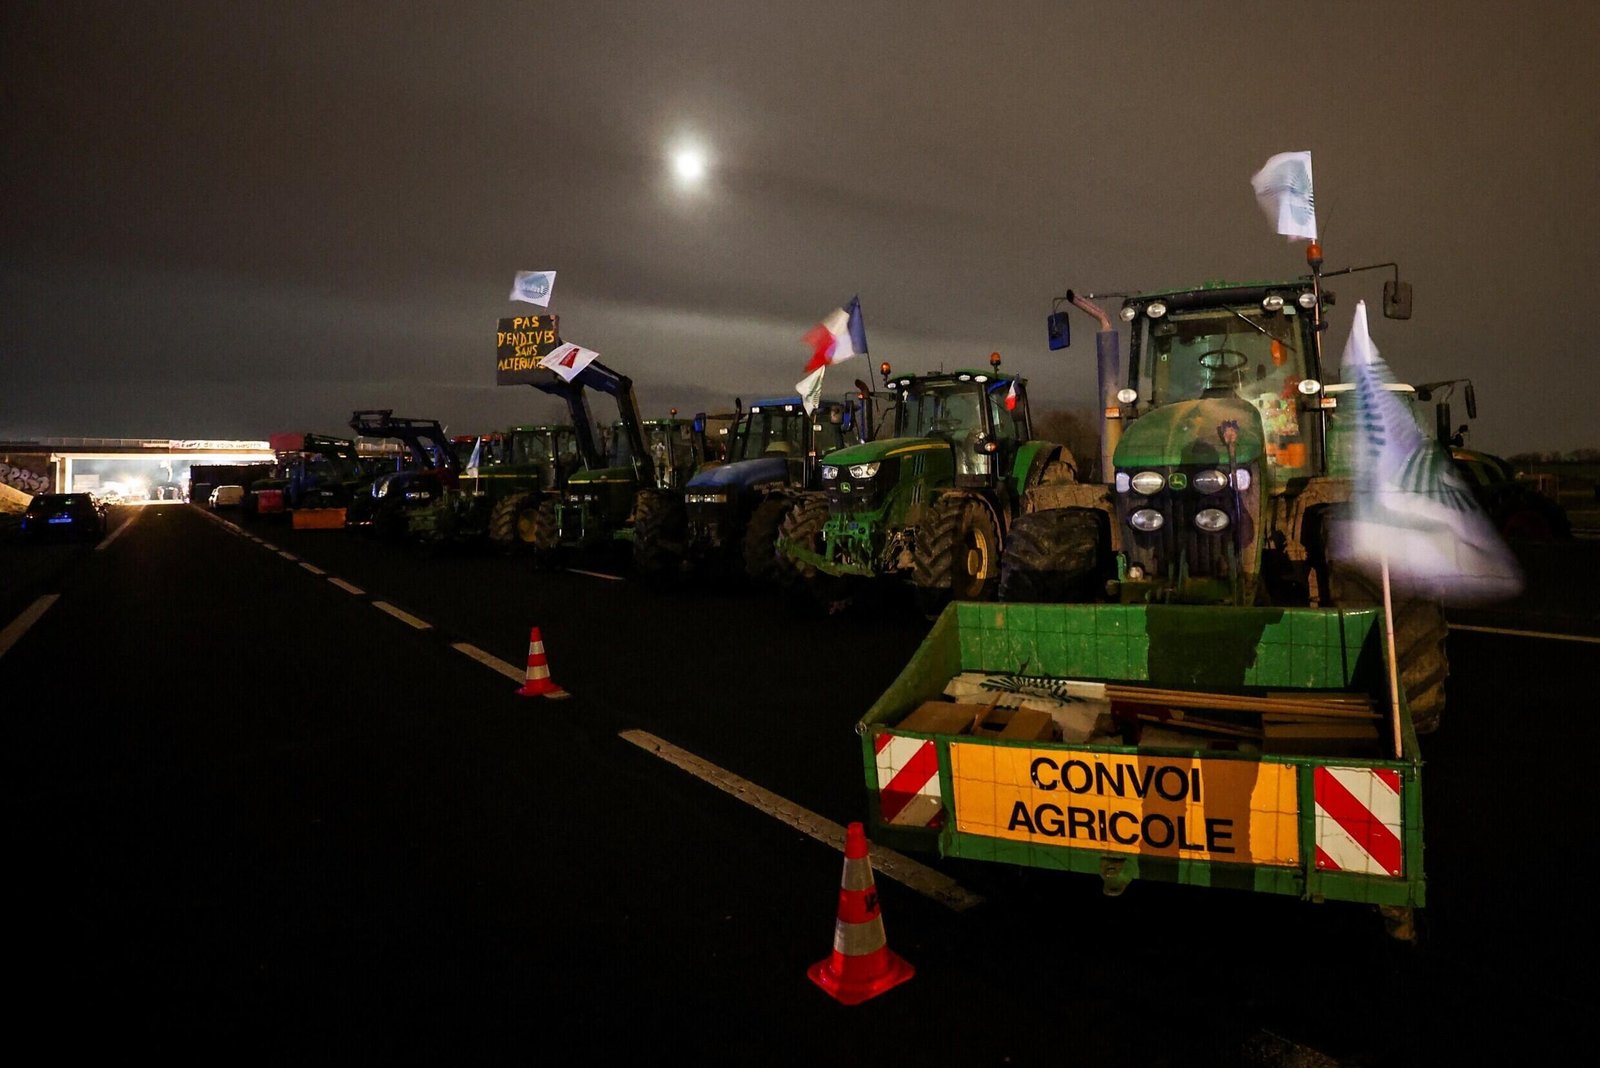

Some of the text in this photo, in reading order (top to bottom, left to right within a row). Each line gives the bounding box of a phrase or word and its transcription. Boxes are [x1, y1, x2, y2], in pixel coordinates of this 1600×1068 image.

[513, 315, 539, 329] PAS
[515, 345, 538, 357] SANS
[1030, 757, 1202, 803] CONVOI
[1008, 800, 1235, 854] AGRICOLE
